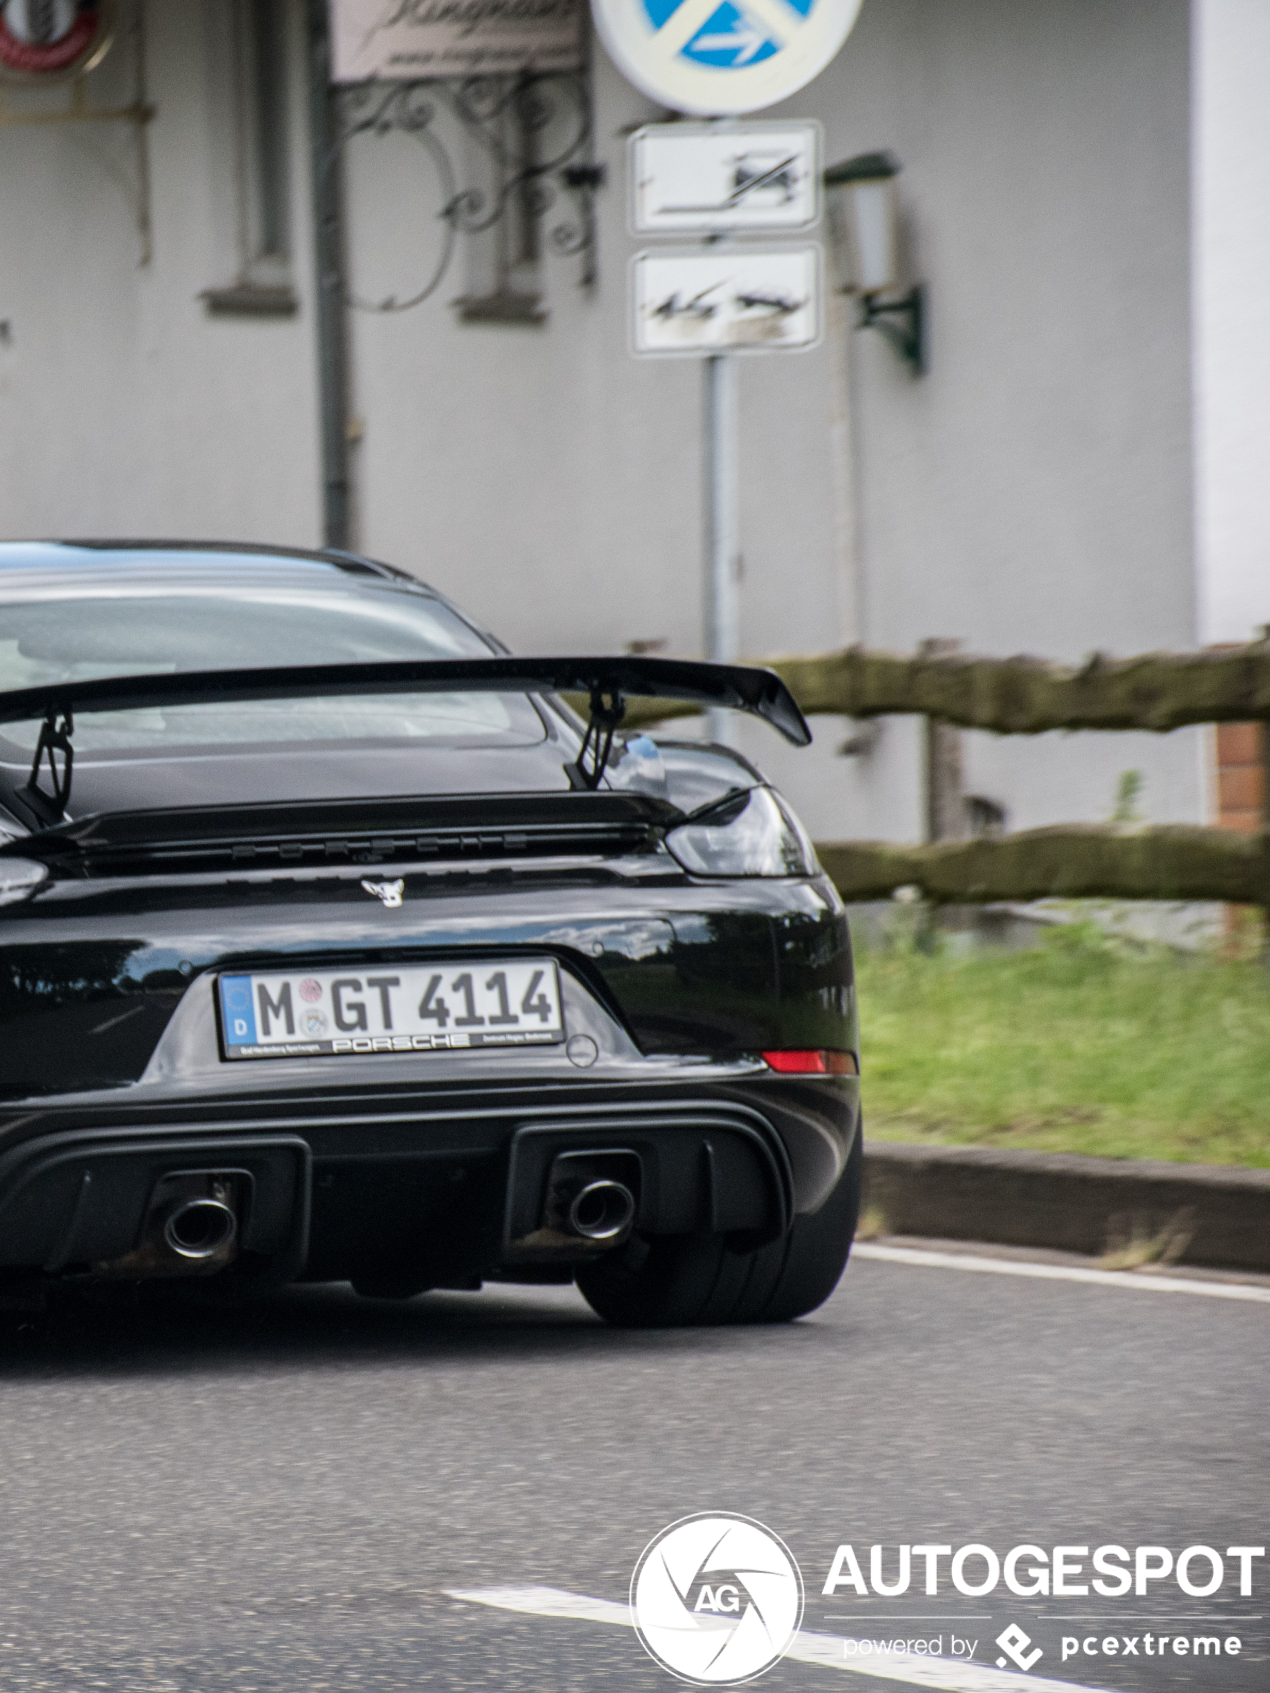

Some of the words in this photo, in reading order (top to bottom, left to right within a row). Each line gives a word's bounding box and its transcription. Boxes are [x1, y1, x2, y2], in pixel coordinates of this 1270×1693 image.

[257, 981, 295, 1037] M
[330, 975, 401, 1033] GT
[418, 970, 553, 1029] 4114
[234, 1018, 248, 1036] D
[332, 1033, 472, 1054] PORSCHE
